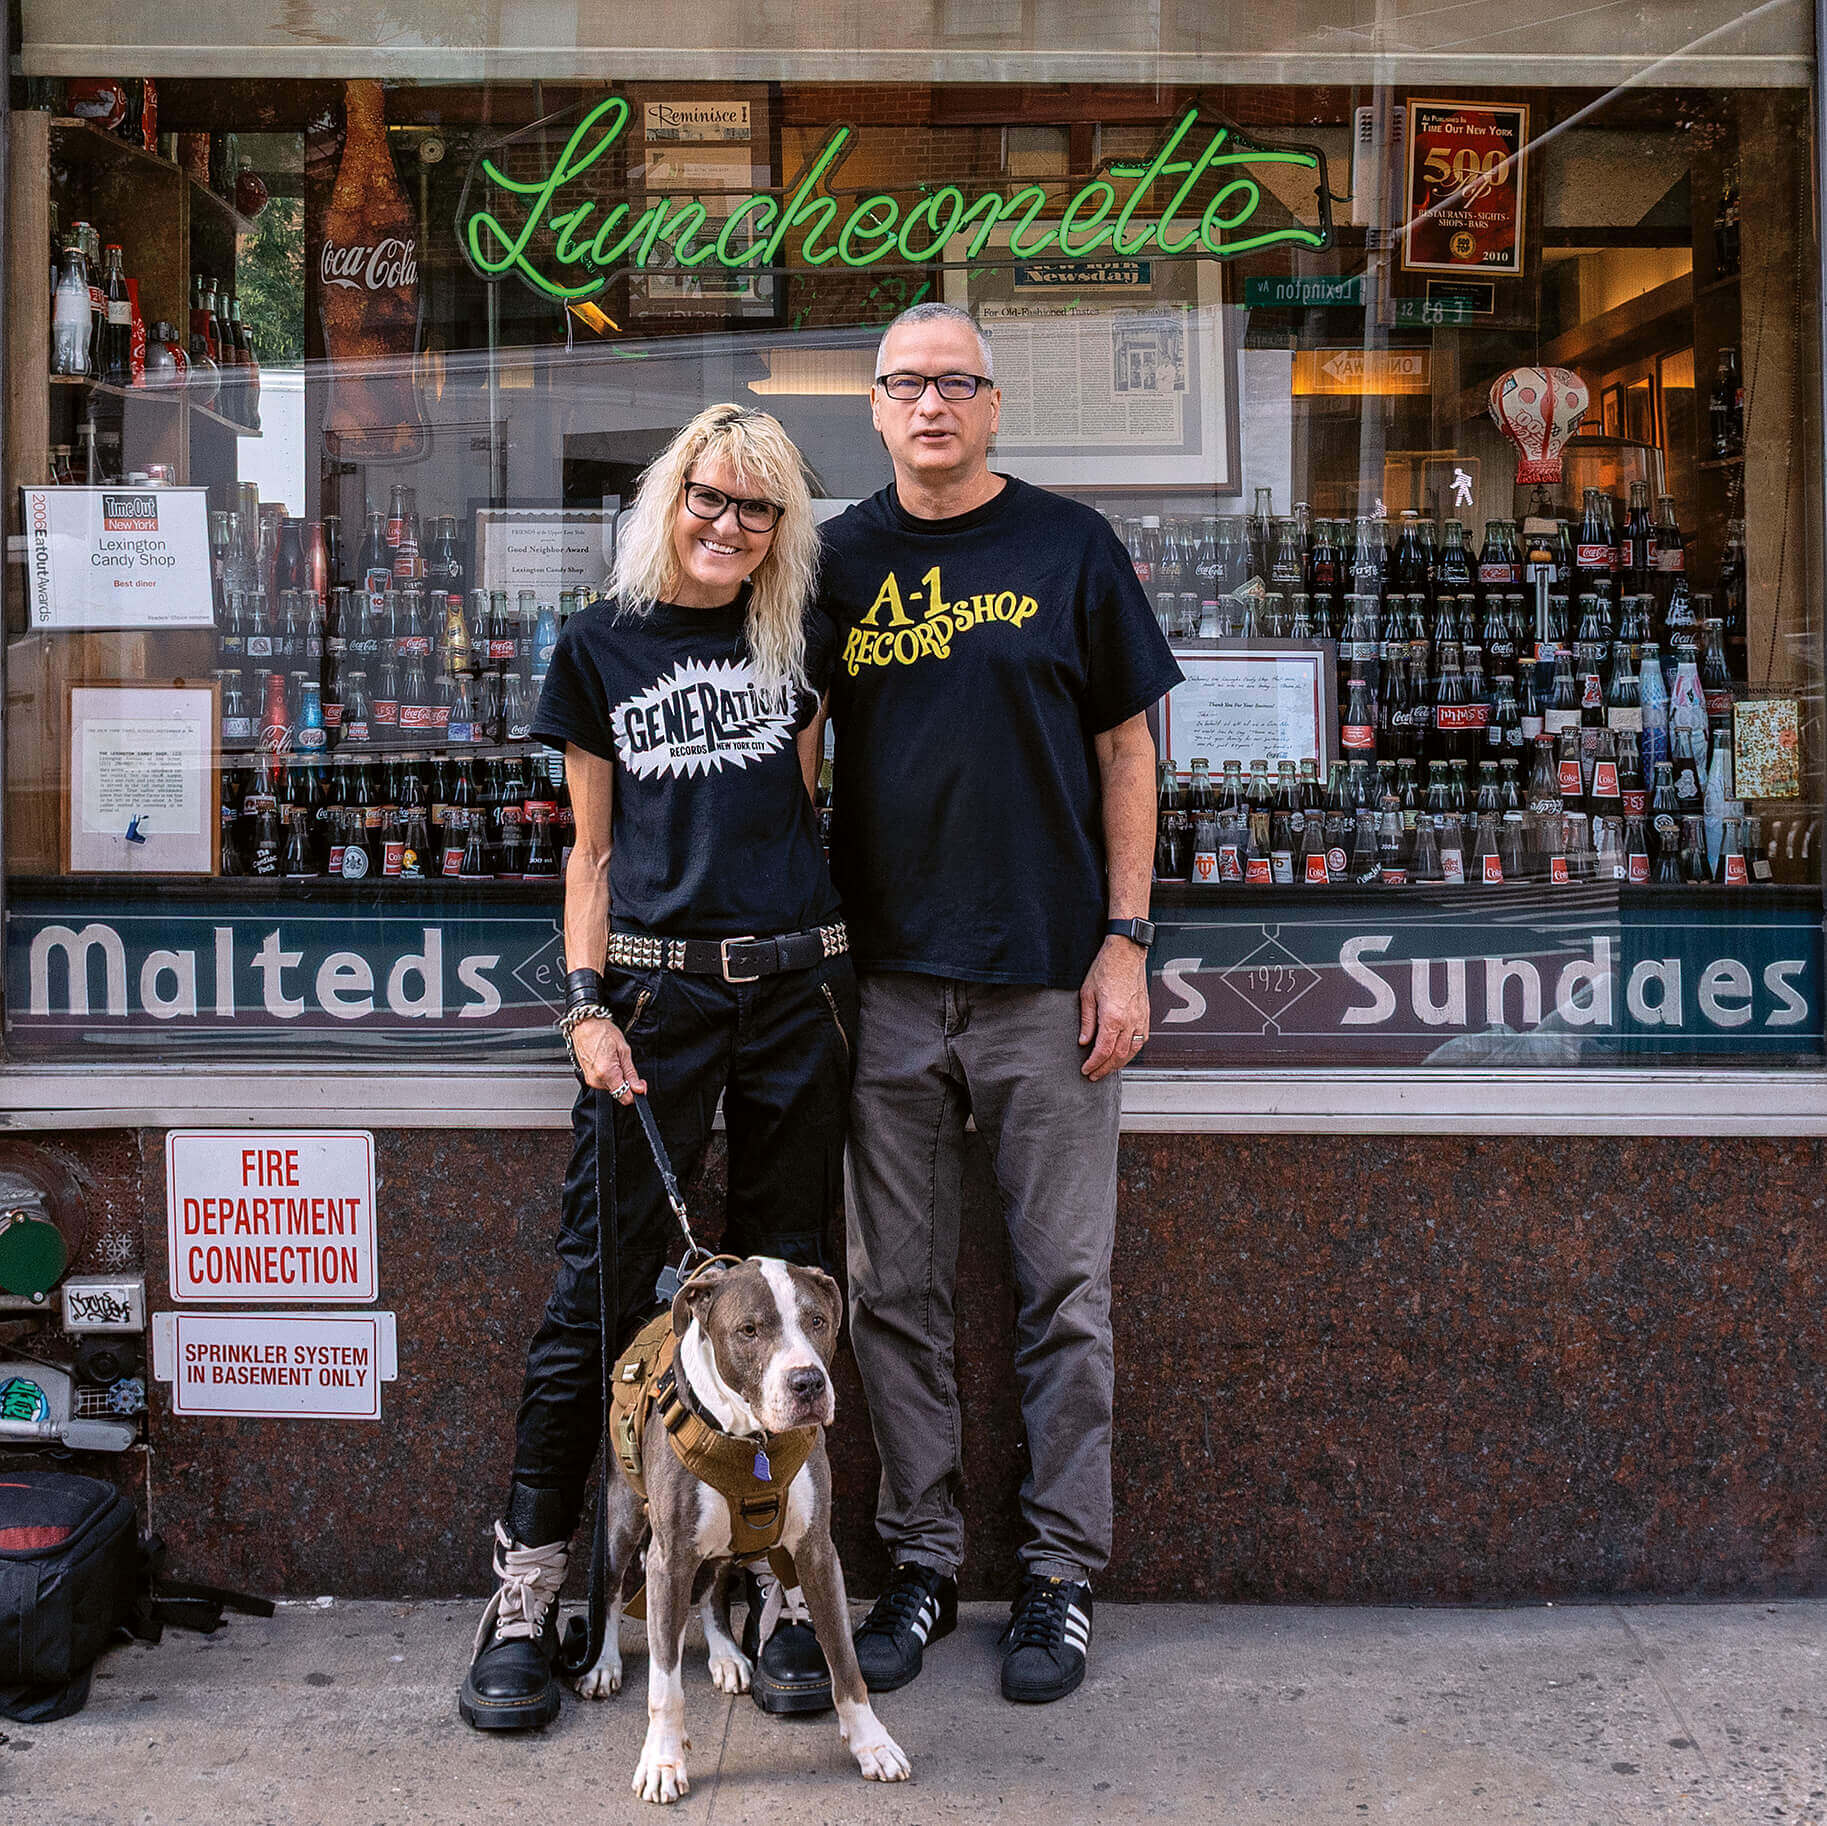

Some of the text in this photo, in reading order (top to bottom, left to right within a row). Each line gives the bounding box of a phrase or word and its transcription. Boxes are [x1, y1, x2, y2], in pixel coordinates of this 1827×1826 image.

[648, 104, 737, 128] Reminisce
[1423, 147, 1510, 186] 500
[468, 97, 1326, 296] Luncheonette
[321, 239, 418, 290] Coca-Cola
[1483, 251, 1509, 262] 2010
[1024, 269, 1139, 283] Newsday
[108, 519, 156, 529] New York
[99, 538, 166, 554] Lexington
[529, 546, 564, 555] Neighbor
[91, 553, 176, 568] Candy Shop
[511, 566, 544, 574] Lexington
[113, 579, 157, 587] Best diner
[860, 566, 951, 627] A-1
[842, 591, 1039, 677] RECORD SHOP
[669, 742, 765, 757] RECORDS NEW YORK CITY
[1559, 773, 1578, 784] Coke
[1598, 773, 1615, 784] Coke
[29, 923, 502, 1020] Malteds
[1248, 971, 1297, 994] 1925
[1340, 936, 1809, 1028] Sundaes
[241, 1149, 300, 1187] FIRE
[183, 1197, 361, 1236] DEPARTMENT
[188, 1245, 358, 1284] CONNECTION
[185, 1343, 369, 1367] SPRINKLER SYSTEM
[187, 1365, 368, 1388] IN BASEMENT ONLY
